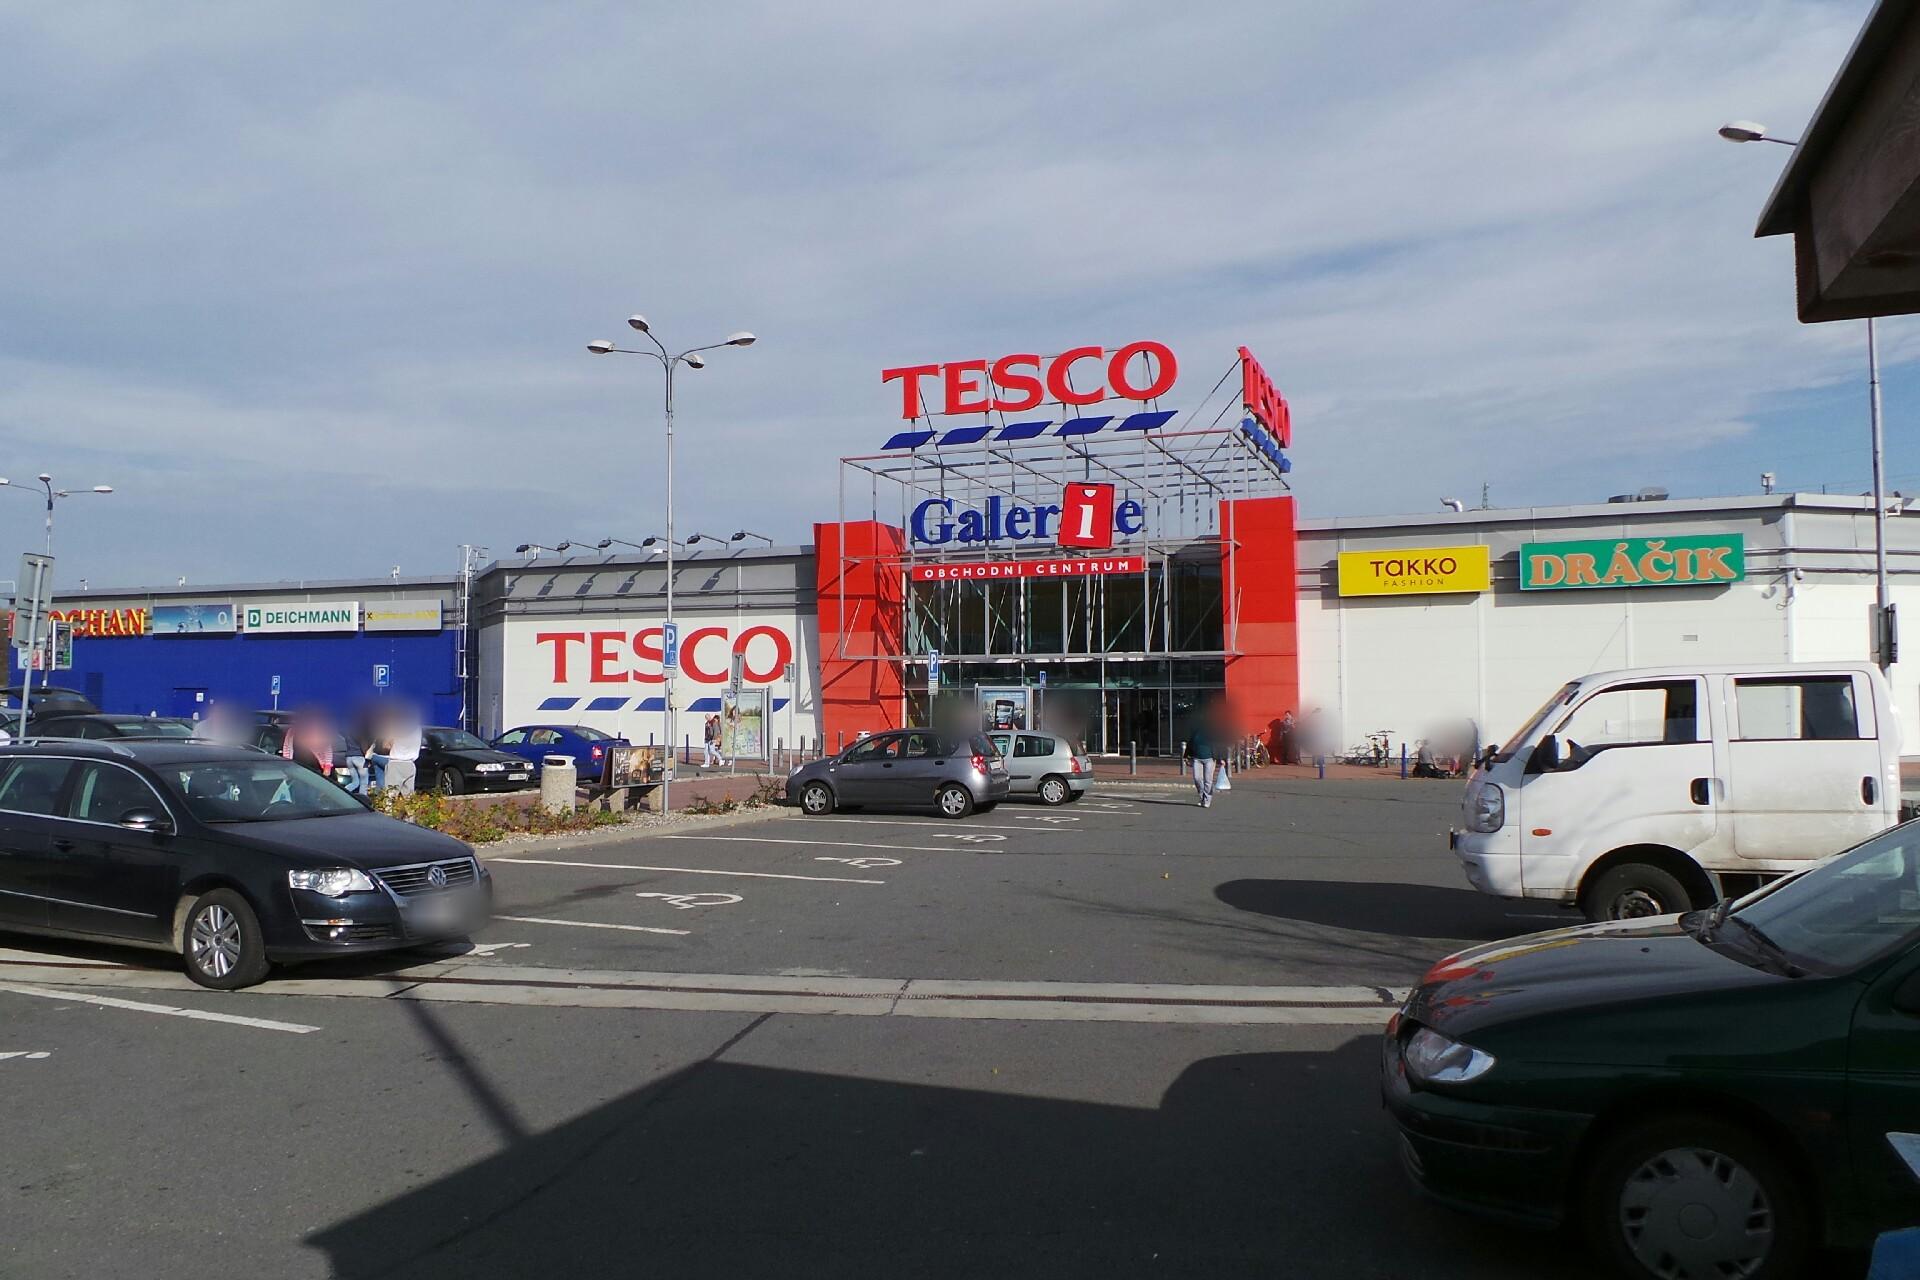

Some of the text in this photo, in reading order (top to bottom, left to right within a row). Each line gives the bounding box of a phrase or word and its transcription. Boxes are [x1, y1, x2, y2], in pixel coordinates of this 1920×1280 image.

[881, 341, 1178, 420] TESCO
[911, 483, 1143, 548] Galerie
[924, 560, 1129, 579] OBCHODNÍ CENTRUM
[1529, 541, 1737, 585] DRÁČIK
[1383, 578, 1445, 587] FASHION
[266, 610, 351, 624] DEICHMANN
[666, 628, 675, 653] P
[536, 625, 793, 684] TESCO
[930, 654, 937, 671] P
[378, 667, 386, 681] P
